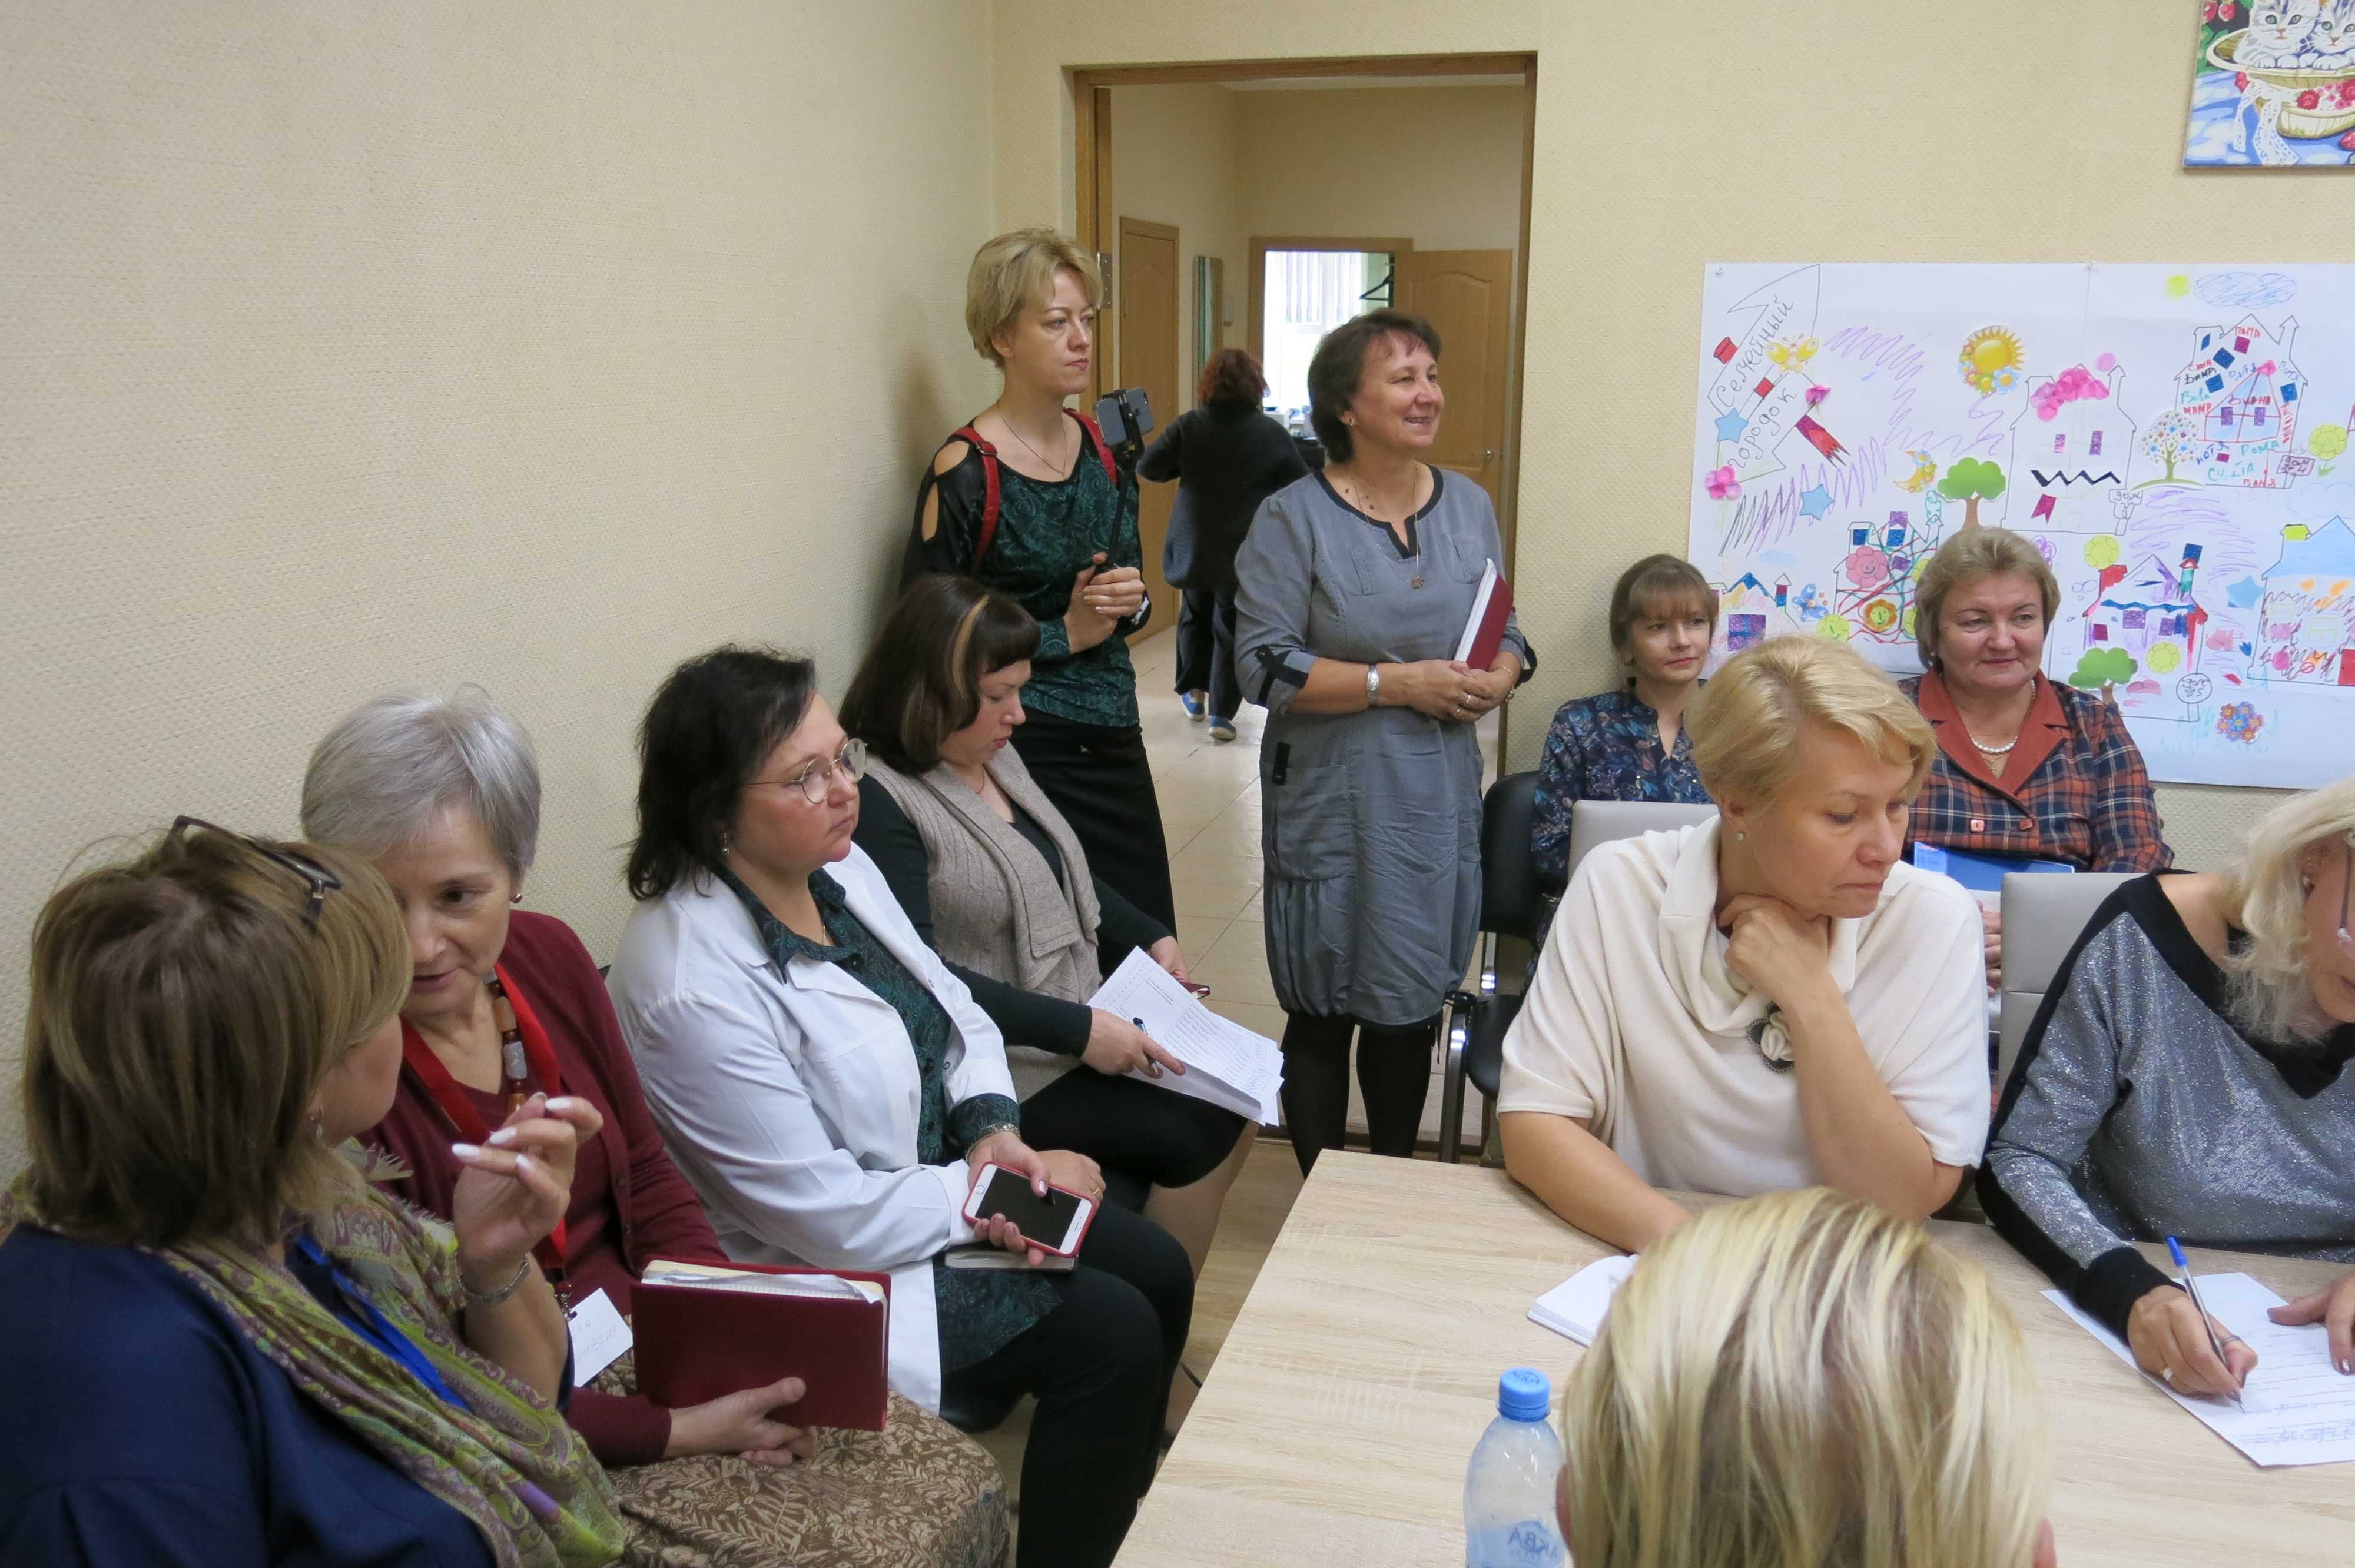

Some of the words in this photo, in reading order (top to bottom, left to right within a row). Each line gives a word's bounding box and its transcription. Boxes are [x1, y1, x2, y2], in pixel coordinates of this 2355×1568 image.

[1716, 294, 1794, 407] Семейный
[1727, 388, 1797, 470] городок
[2297, 465, 2307, 474] 4
[2196, 687, 2205, 697] 5
